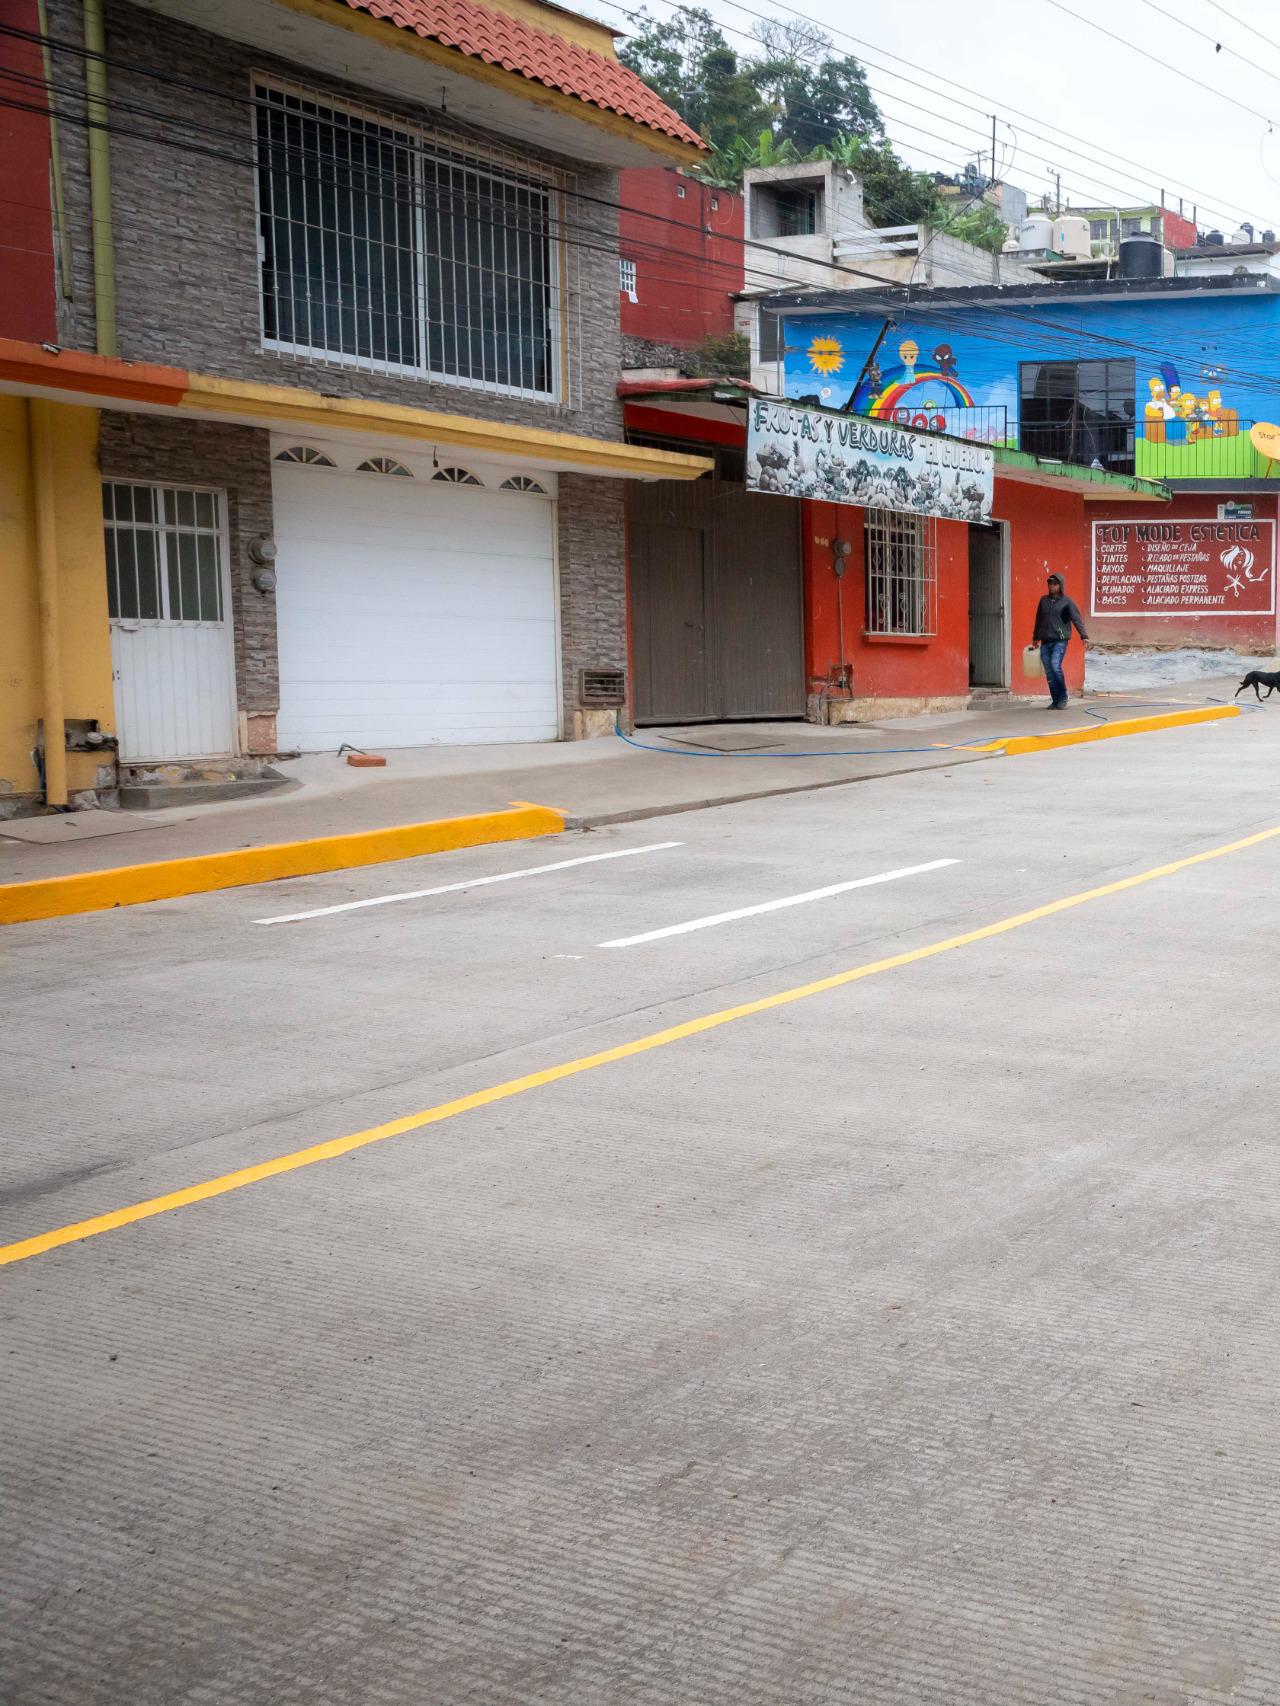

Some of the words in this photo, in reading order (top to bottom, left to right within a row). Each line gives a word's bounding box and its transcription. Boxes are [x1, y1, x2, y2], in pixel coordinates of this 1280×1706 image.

[755, 401, 820, 443] FRUTAS
[823, 419, 834, 443] Y
[838, 421, 917, 462] VERDURAS
[1097, 526, 1130, 544] TOP
[1135, 525, 1183, 543] MODE
[1190, 524, 1261, 542] ESTETICA
[1100, 544, 1127, 553] CORTES
[1147, 542, 1171, 552] DISEÑO
[1179, 543, 1197, 552] CEJA
[1102, 554, 1129, 563] TINTES
[1147, 553, 1172, 563] RIZADO
[1179, 552, 1211, 562] PESTAÑAS
[1101, 564, 1125, 573] RAYOS
[1146, 563, 1190, 573] MAQUILLAJE
[1101, 575, 1142, 584] DEPILACION
[1146, 573, 1178, 583] PESTAÑAS
[1179, 574, 1208, 583] POSTIZAS
[1101, 585, 1136, 594] PEINADOS
[1146, 585, 1180, 594] ALACIADO
[1180, 585, 1209, 594] EXPRESS
[1101, 595, 1127, 605] BACES
[1146, 595, 1180, 605] ALACIADO
[1181, 595, 1226, 605] PERMANENTE
